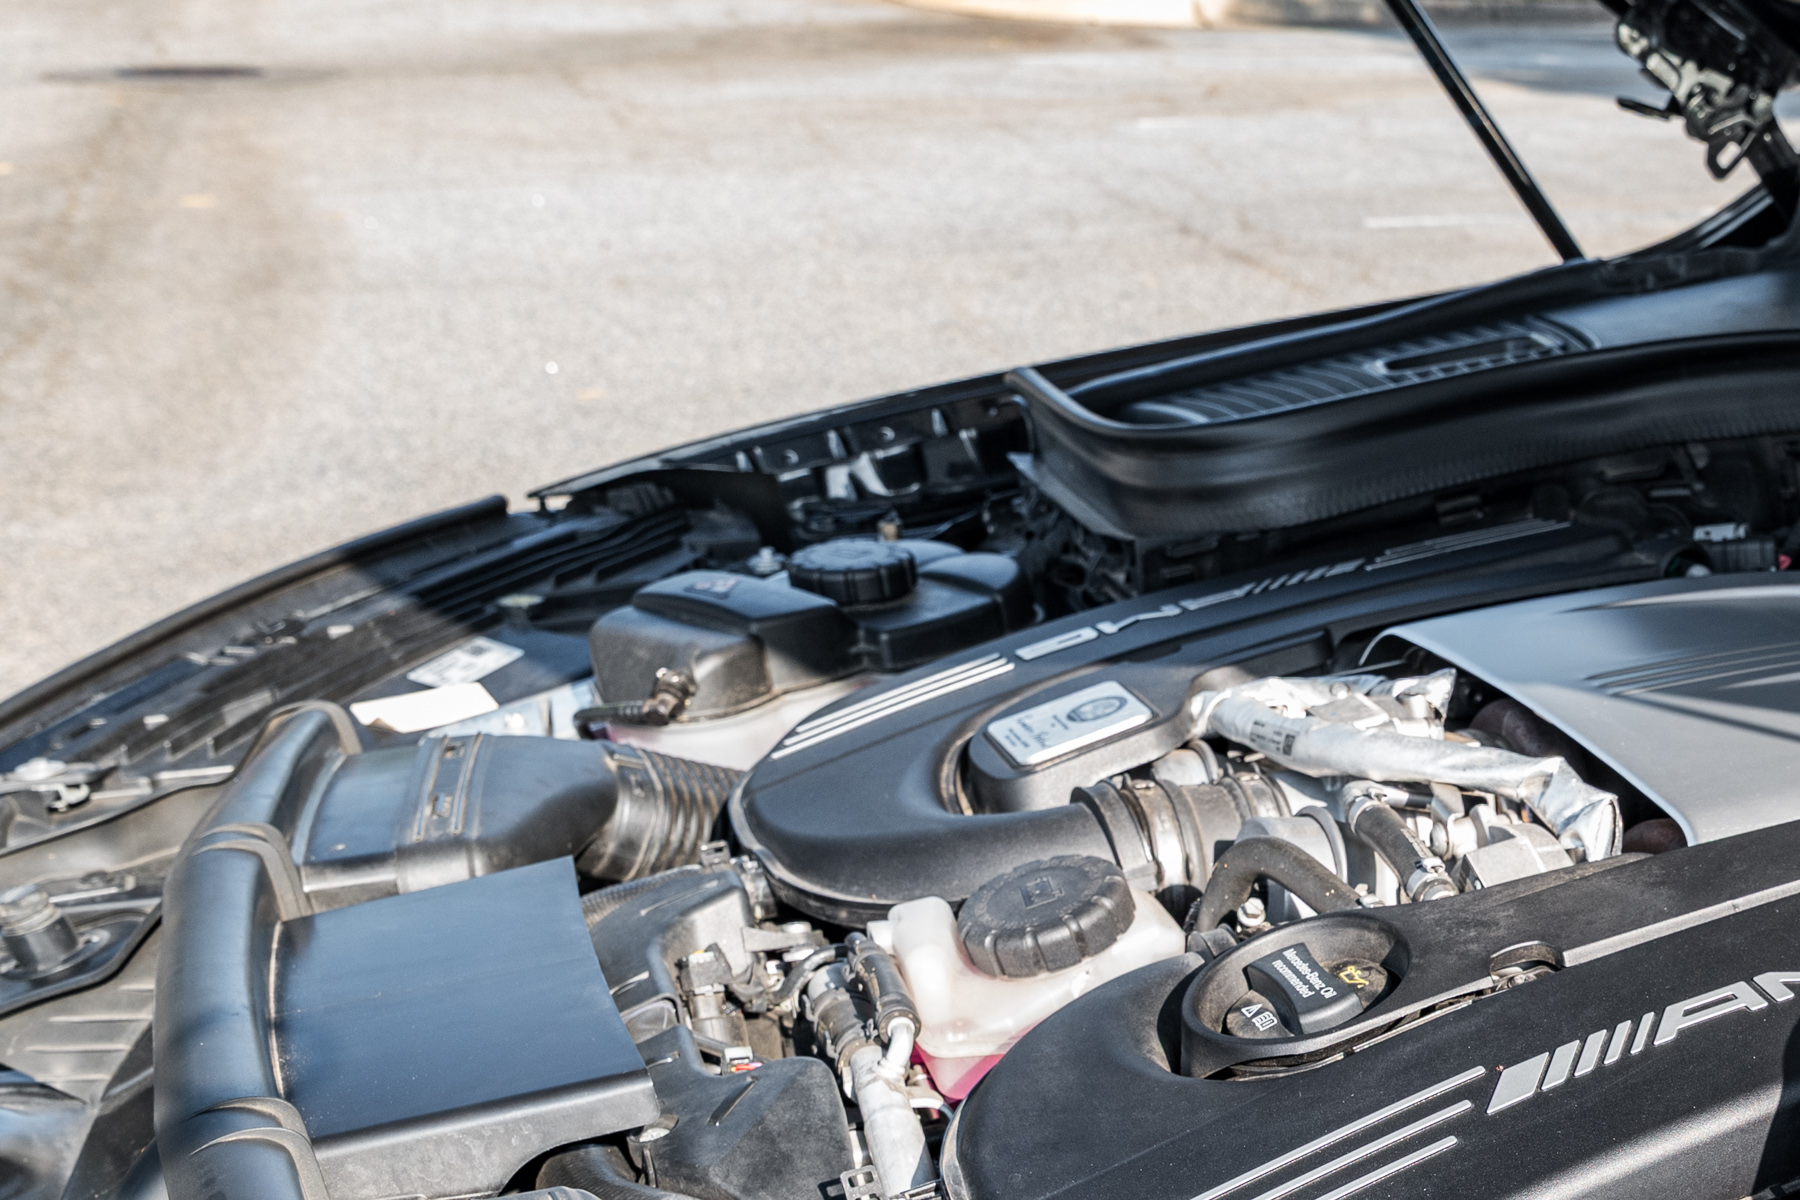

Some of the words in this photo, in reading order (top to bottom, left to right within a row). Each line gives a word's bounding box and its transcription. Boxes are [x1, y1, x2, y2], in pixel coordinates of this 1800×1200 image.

[1015, 582, 1257, 661] AMG
[1272, 959, 1315, 998] recommended
[1282, 948, 1326, 990] Mercedes-Benz
[1320, 987, 1338, 999] Oil
